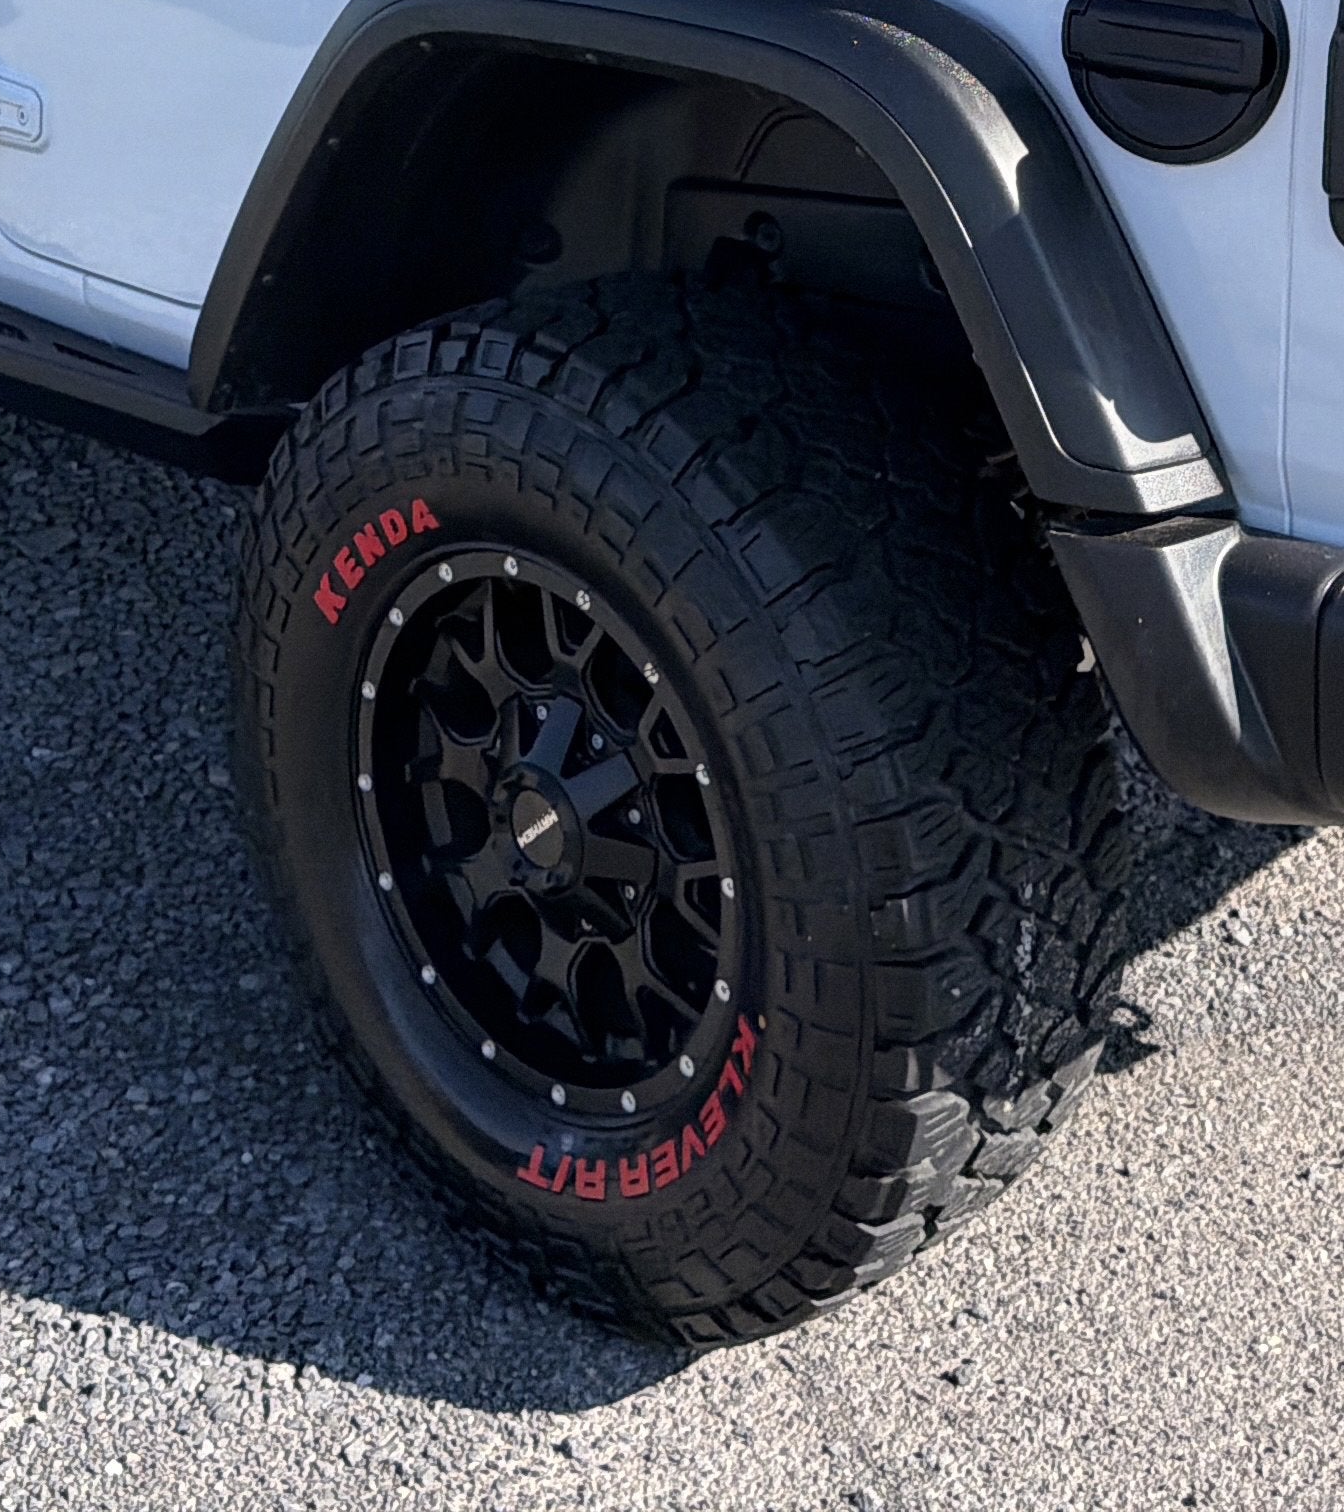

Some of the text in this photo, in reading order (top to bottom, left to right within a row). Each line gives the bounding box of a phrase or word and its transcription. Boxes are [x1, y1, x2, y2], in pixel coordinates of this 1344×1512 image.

[312, 497, 441, 626] KENDA
[516, 1014, 757, 1201] KLEVER R/T
